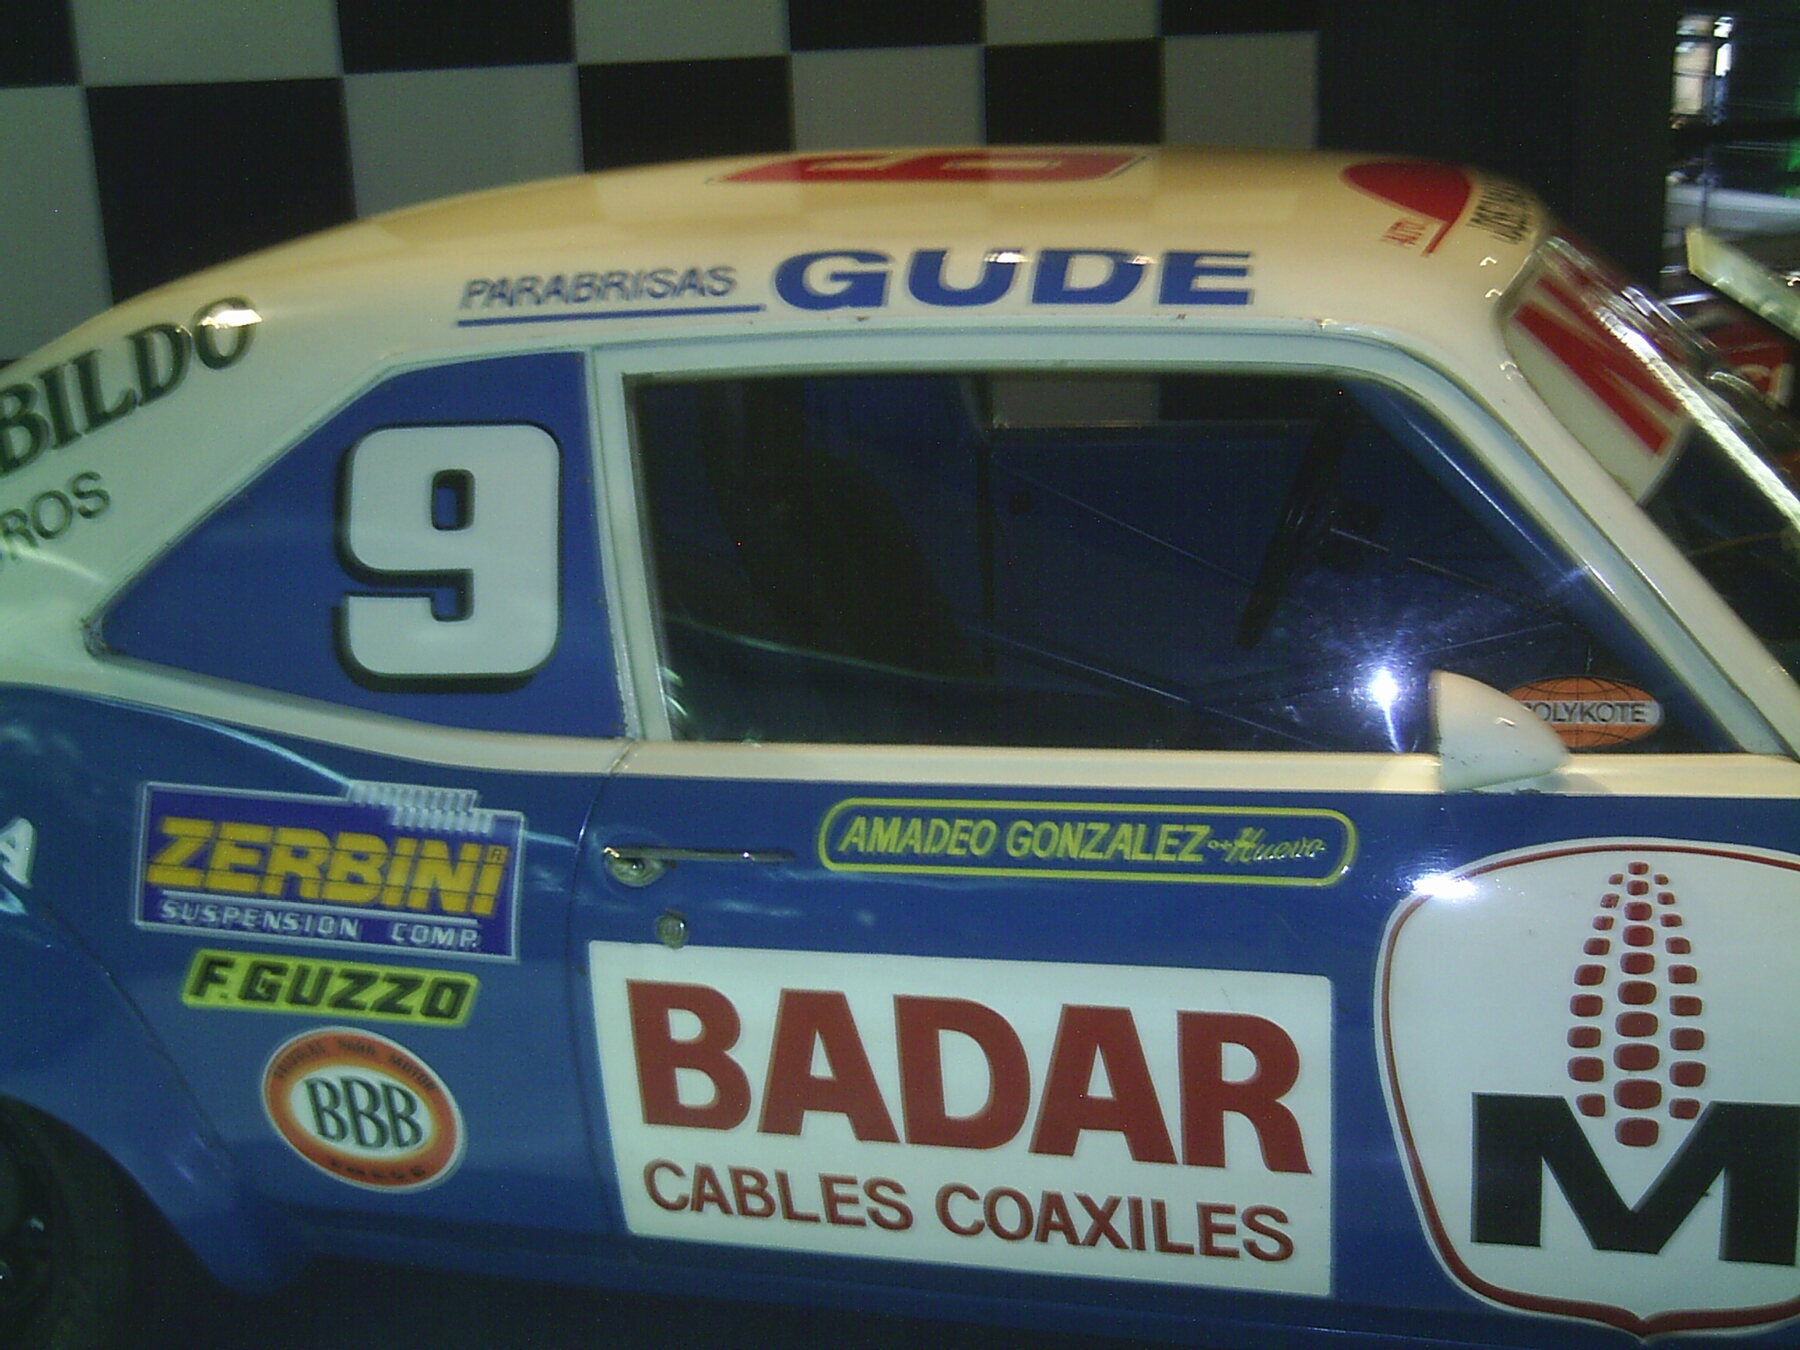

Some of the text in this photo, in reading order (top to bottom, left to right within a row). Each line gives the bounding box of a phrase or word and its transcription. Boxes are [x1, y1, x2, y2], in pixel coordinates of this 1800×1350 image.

[459, 249, 1254, 311] PARABRISAS GUDE
[334, 422, 562, 692] 9
[1524, 702, 1648, 723] OLYKOTE
[146, 816, 510, 916] ZERBINI
[838, 816, 997, 856] AMADEO
[1004, 820, 1211, 862] GONZALEZ
[160, 900, 481, 951] SUSPENSION COMP.
[304, 1076, 425, 1149] BBB
[626, 979, 1313, 1175] BADAR
[643, 1159, 1295, 1263] CABLES COAXILES
[1470, 1092, 1800, 1266] M
